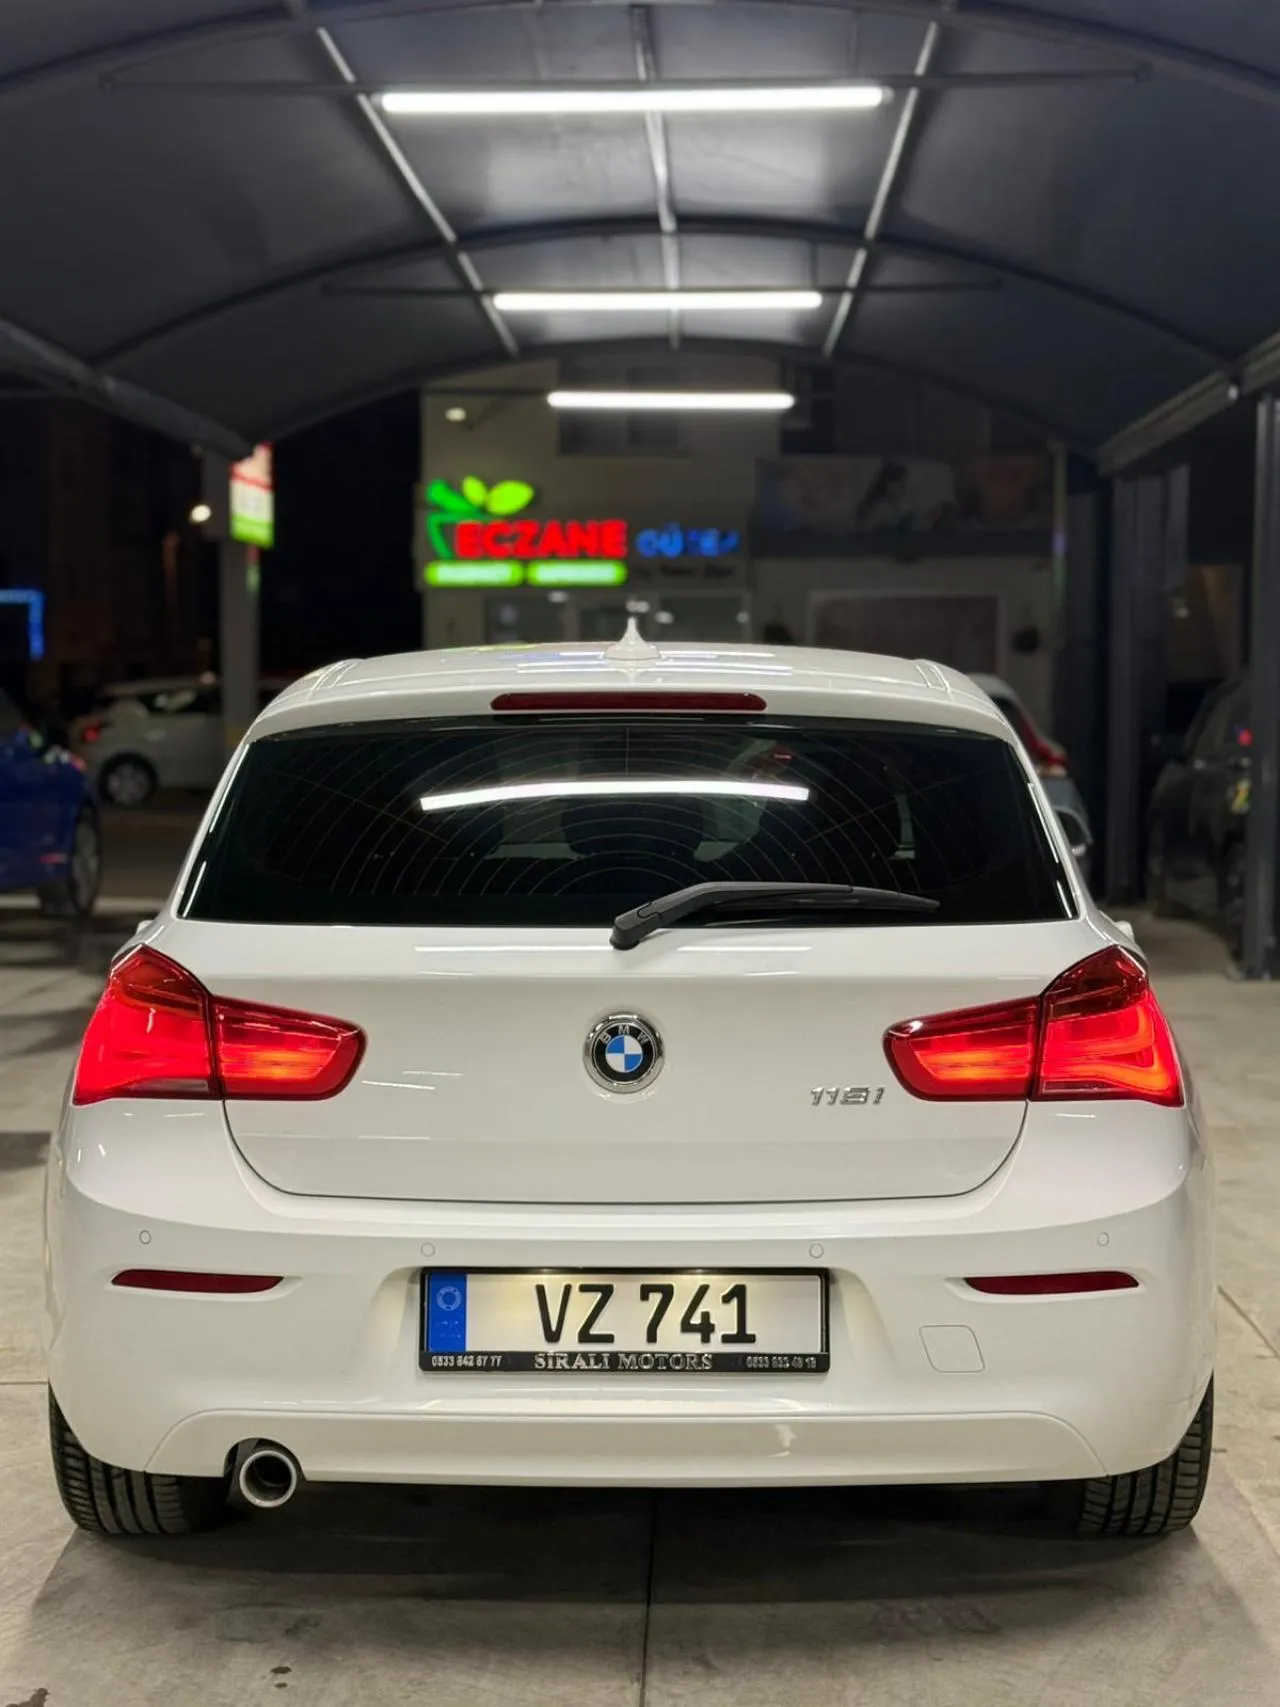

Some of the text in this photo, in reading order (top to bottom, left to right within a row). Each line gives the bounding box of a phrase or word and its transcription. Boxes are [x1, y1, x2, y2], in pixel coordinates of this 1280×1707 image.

[456, 519, 628, 560] ECZANE
[599, 1024, 650, 1045] BMW
[811, 1086, 886, 1106] 118i
[535, 1283, 757, 1344] VZ 741
[431, 1355, 455, 1367] 0533
[617, 1353, 713, 1370] MOTORS
